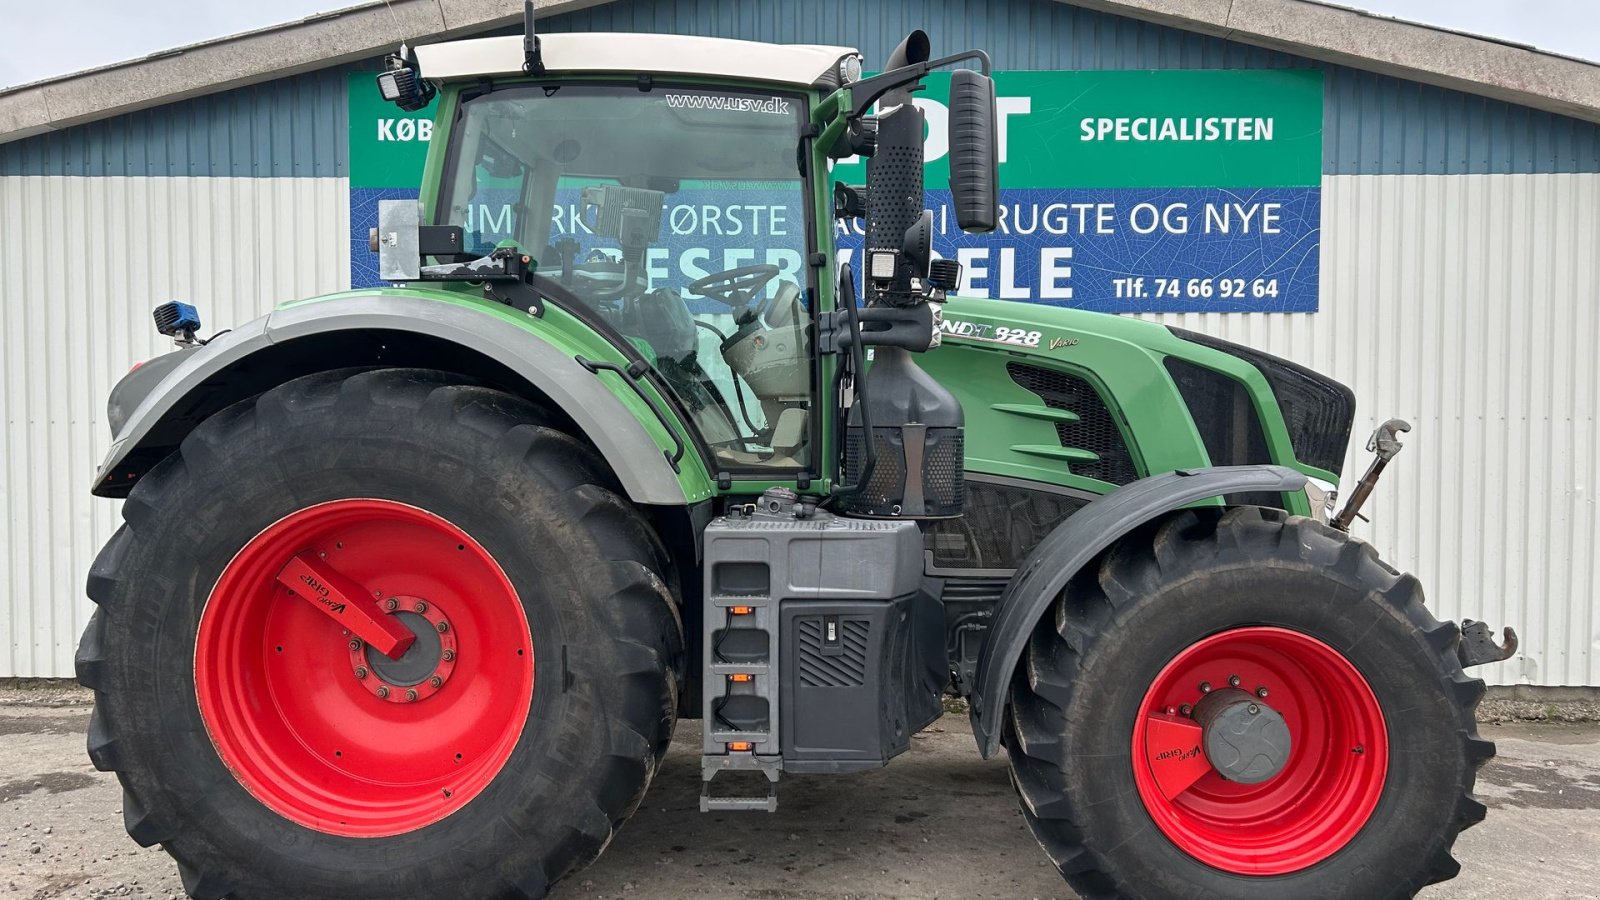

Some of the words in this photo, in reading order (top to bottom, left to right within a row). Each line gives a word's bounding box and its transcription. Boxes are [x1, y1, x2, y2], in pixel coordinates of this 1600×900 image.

[665, 94, 789, 115] www.usv.dk
[1080, 117, 1274, 141] SPECIALISTEN
[963, 203, 1115, 234] RUGTE
[1130, 203, 1188, 234] OG
[1205, 203, 1281, 234] NYE
[1113, 277, 1148, 298] Tlf.
[1155, 278, 1180, 298] 74
[1187, 278, 1213, 298] 66
[1219, 278, 1246, 298] 92
[1252, 278, 1279, 298] 64
[995, 326, 1042, 345] 828
[300, 574, 330, 598] GRIP
